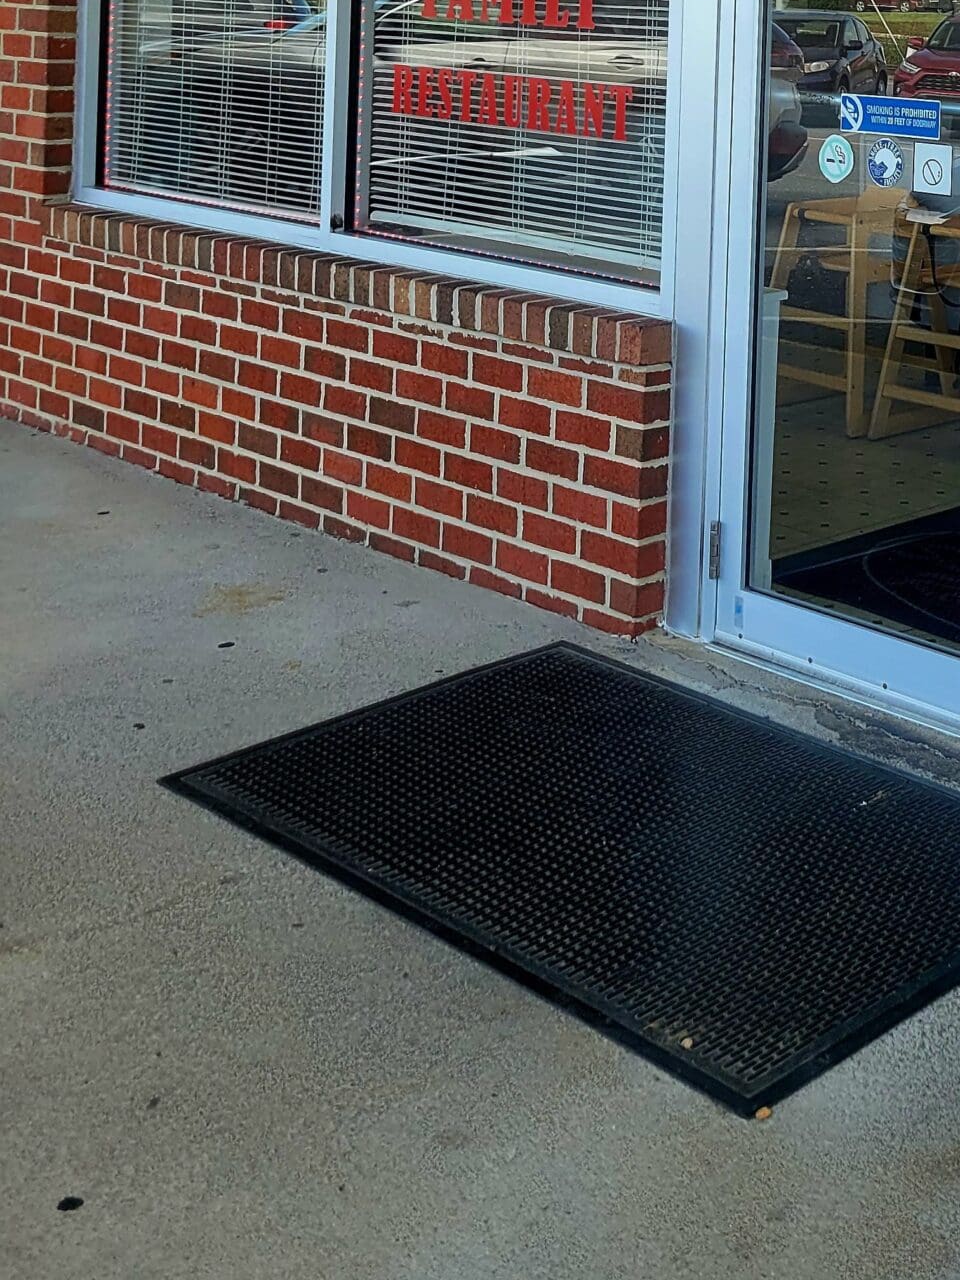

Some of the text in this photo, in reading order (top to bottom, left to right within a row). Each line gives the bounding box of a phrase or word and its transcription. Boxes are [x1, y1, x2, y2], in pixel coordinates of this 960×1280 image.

[392, 63, 633, 142] RESTAURANT
[867, 105, 937, 119] SMOKING IS PROHIBITED
[894, 118, 905, 126] FEET
